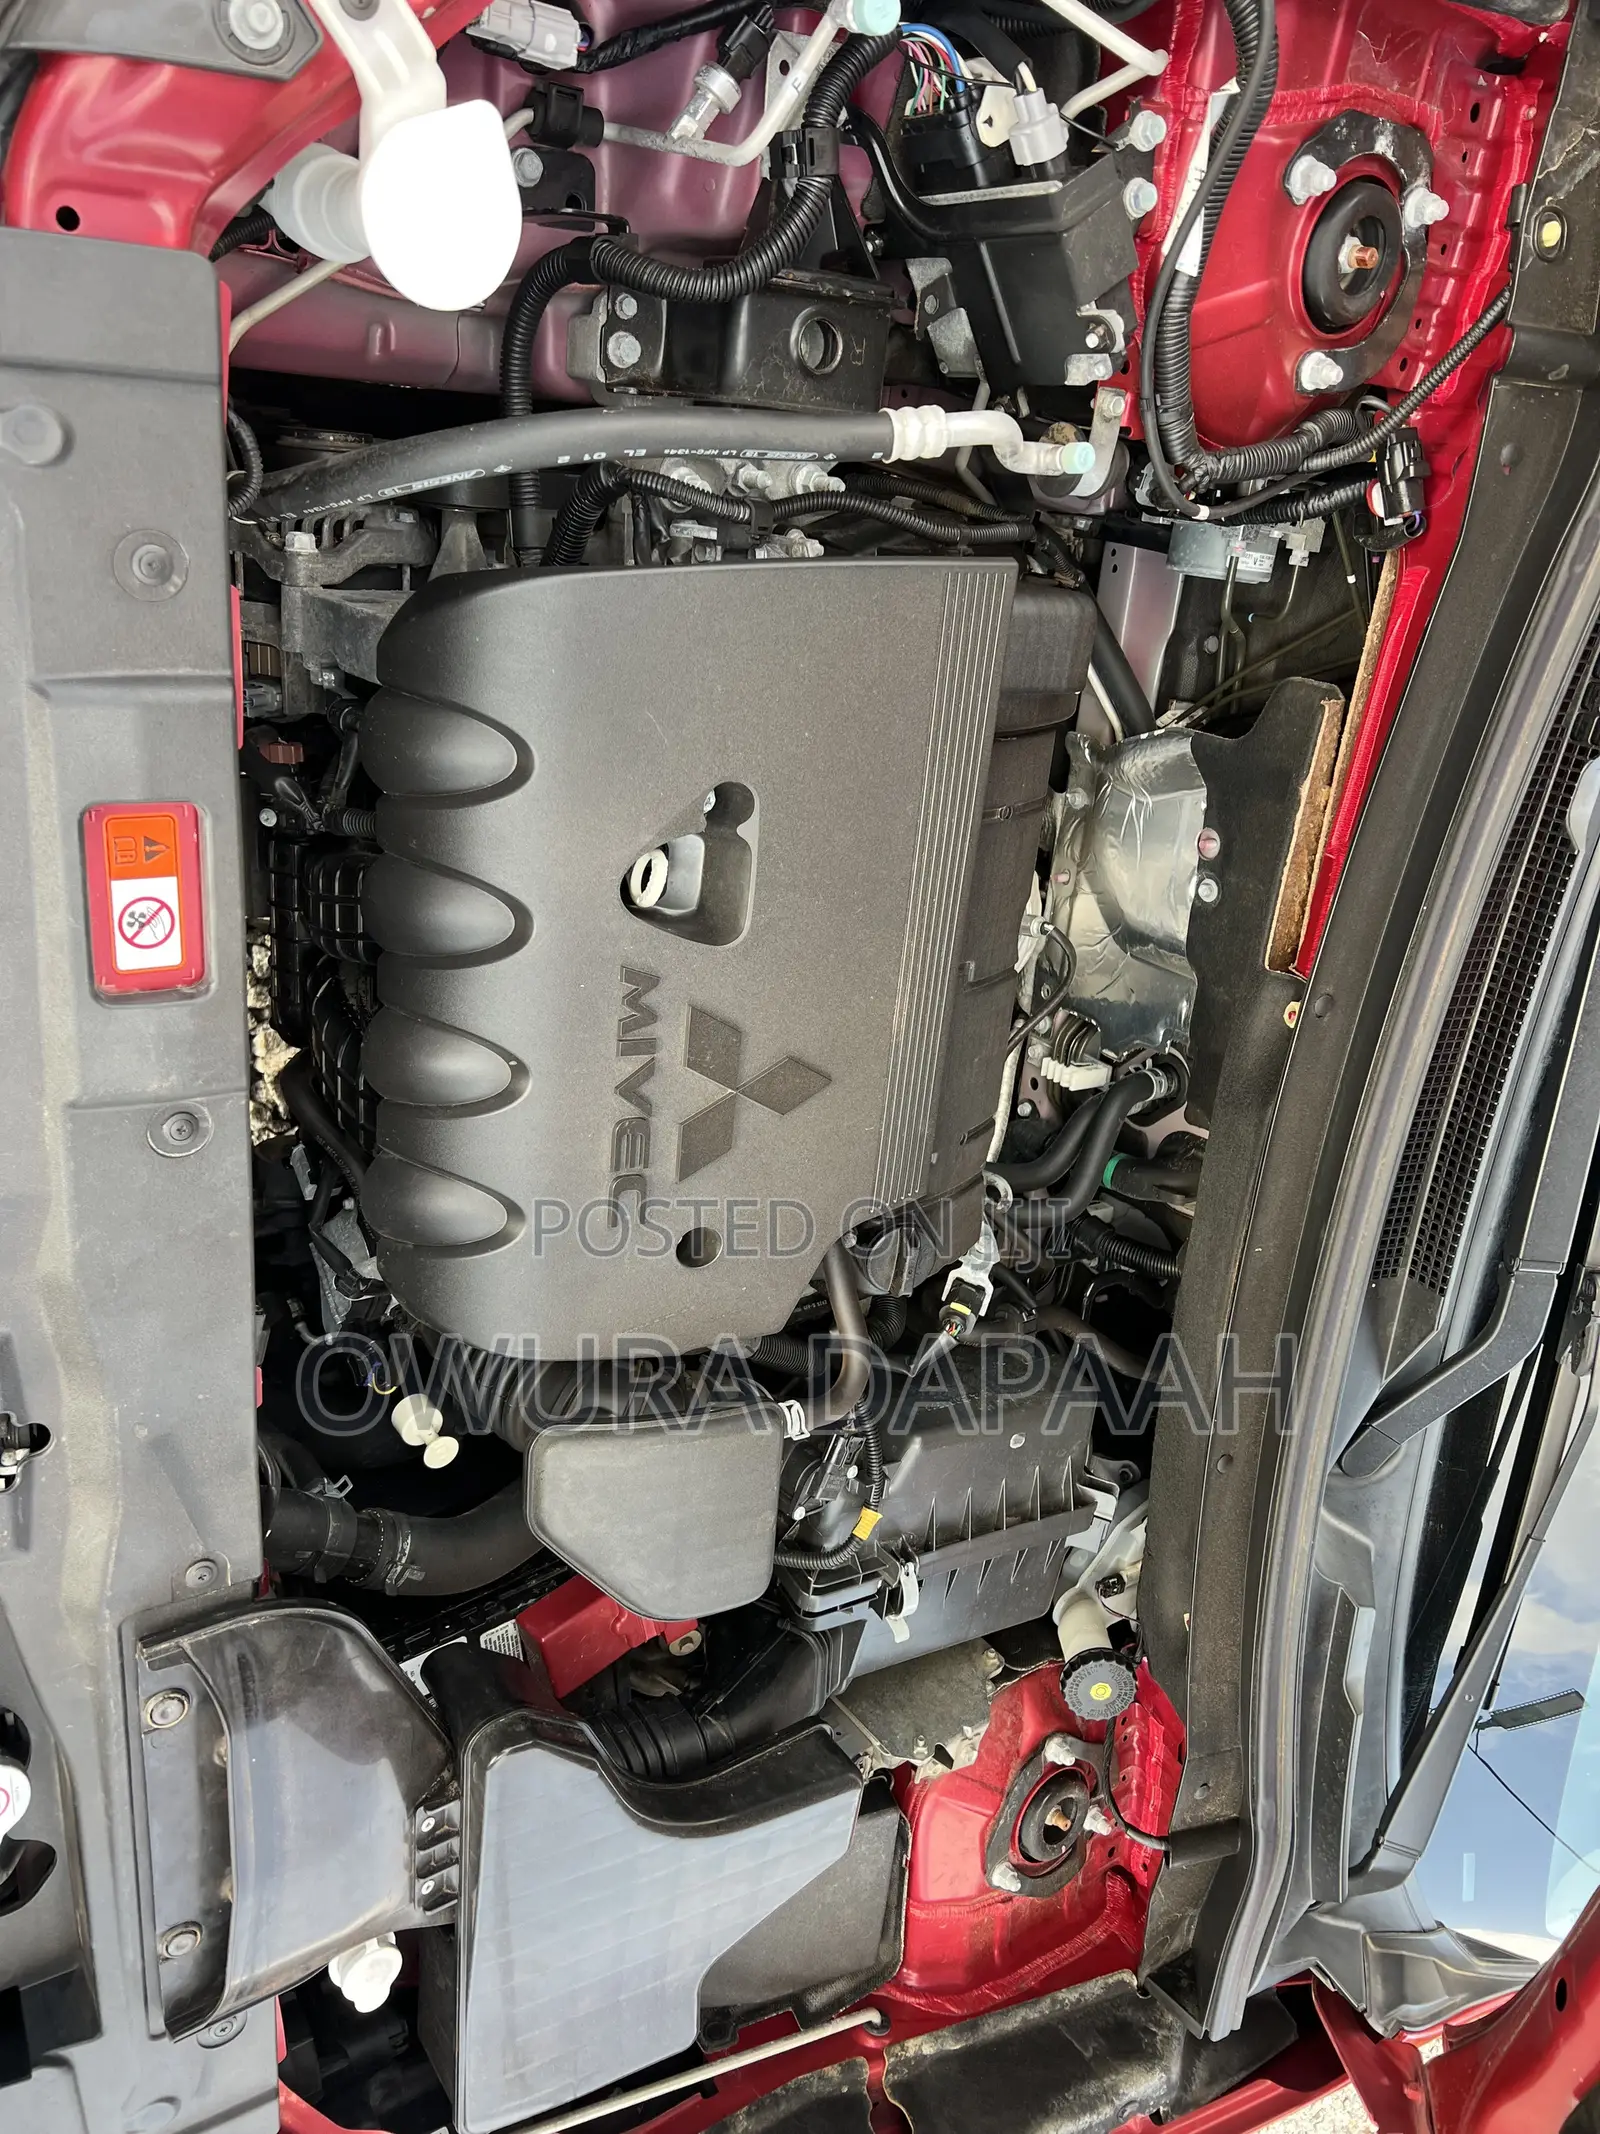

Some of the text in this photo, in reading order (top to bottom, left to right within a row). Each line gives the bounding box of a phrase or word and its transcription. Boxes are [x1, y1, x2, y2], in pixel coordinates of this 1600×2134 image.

[582, 451, 607, 461] 01
[623, 448, 647, 457] EL
[607, 965, 661, 1228] MIVEC
